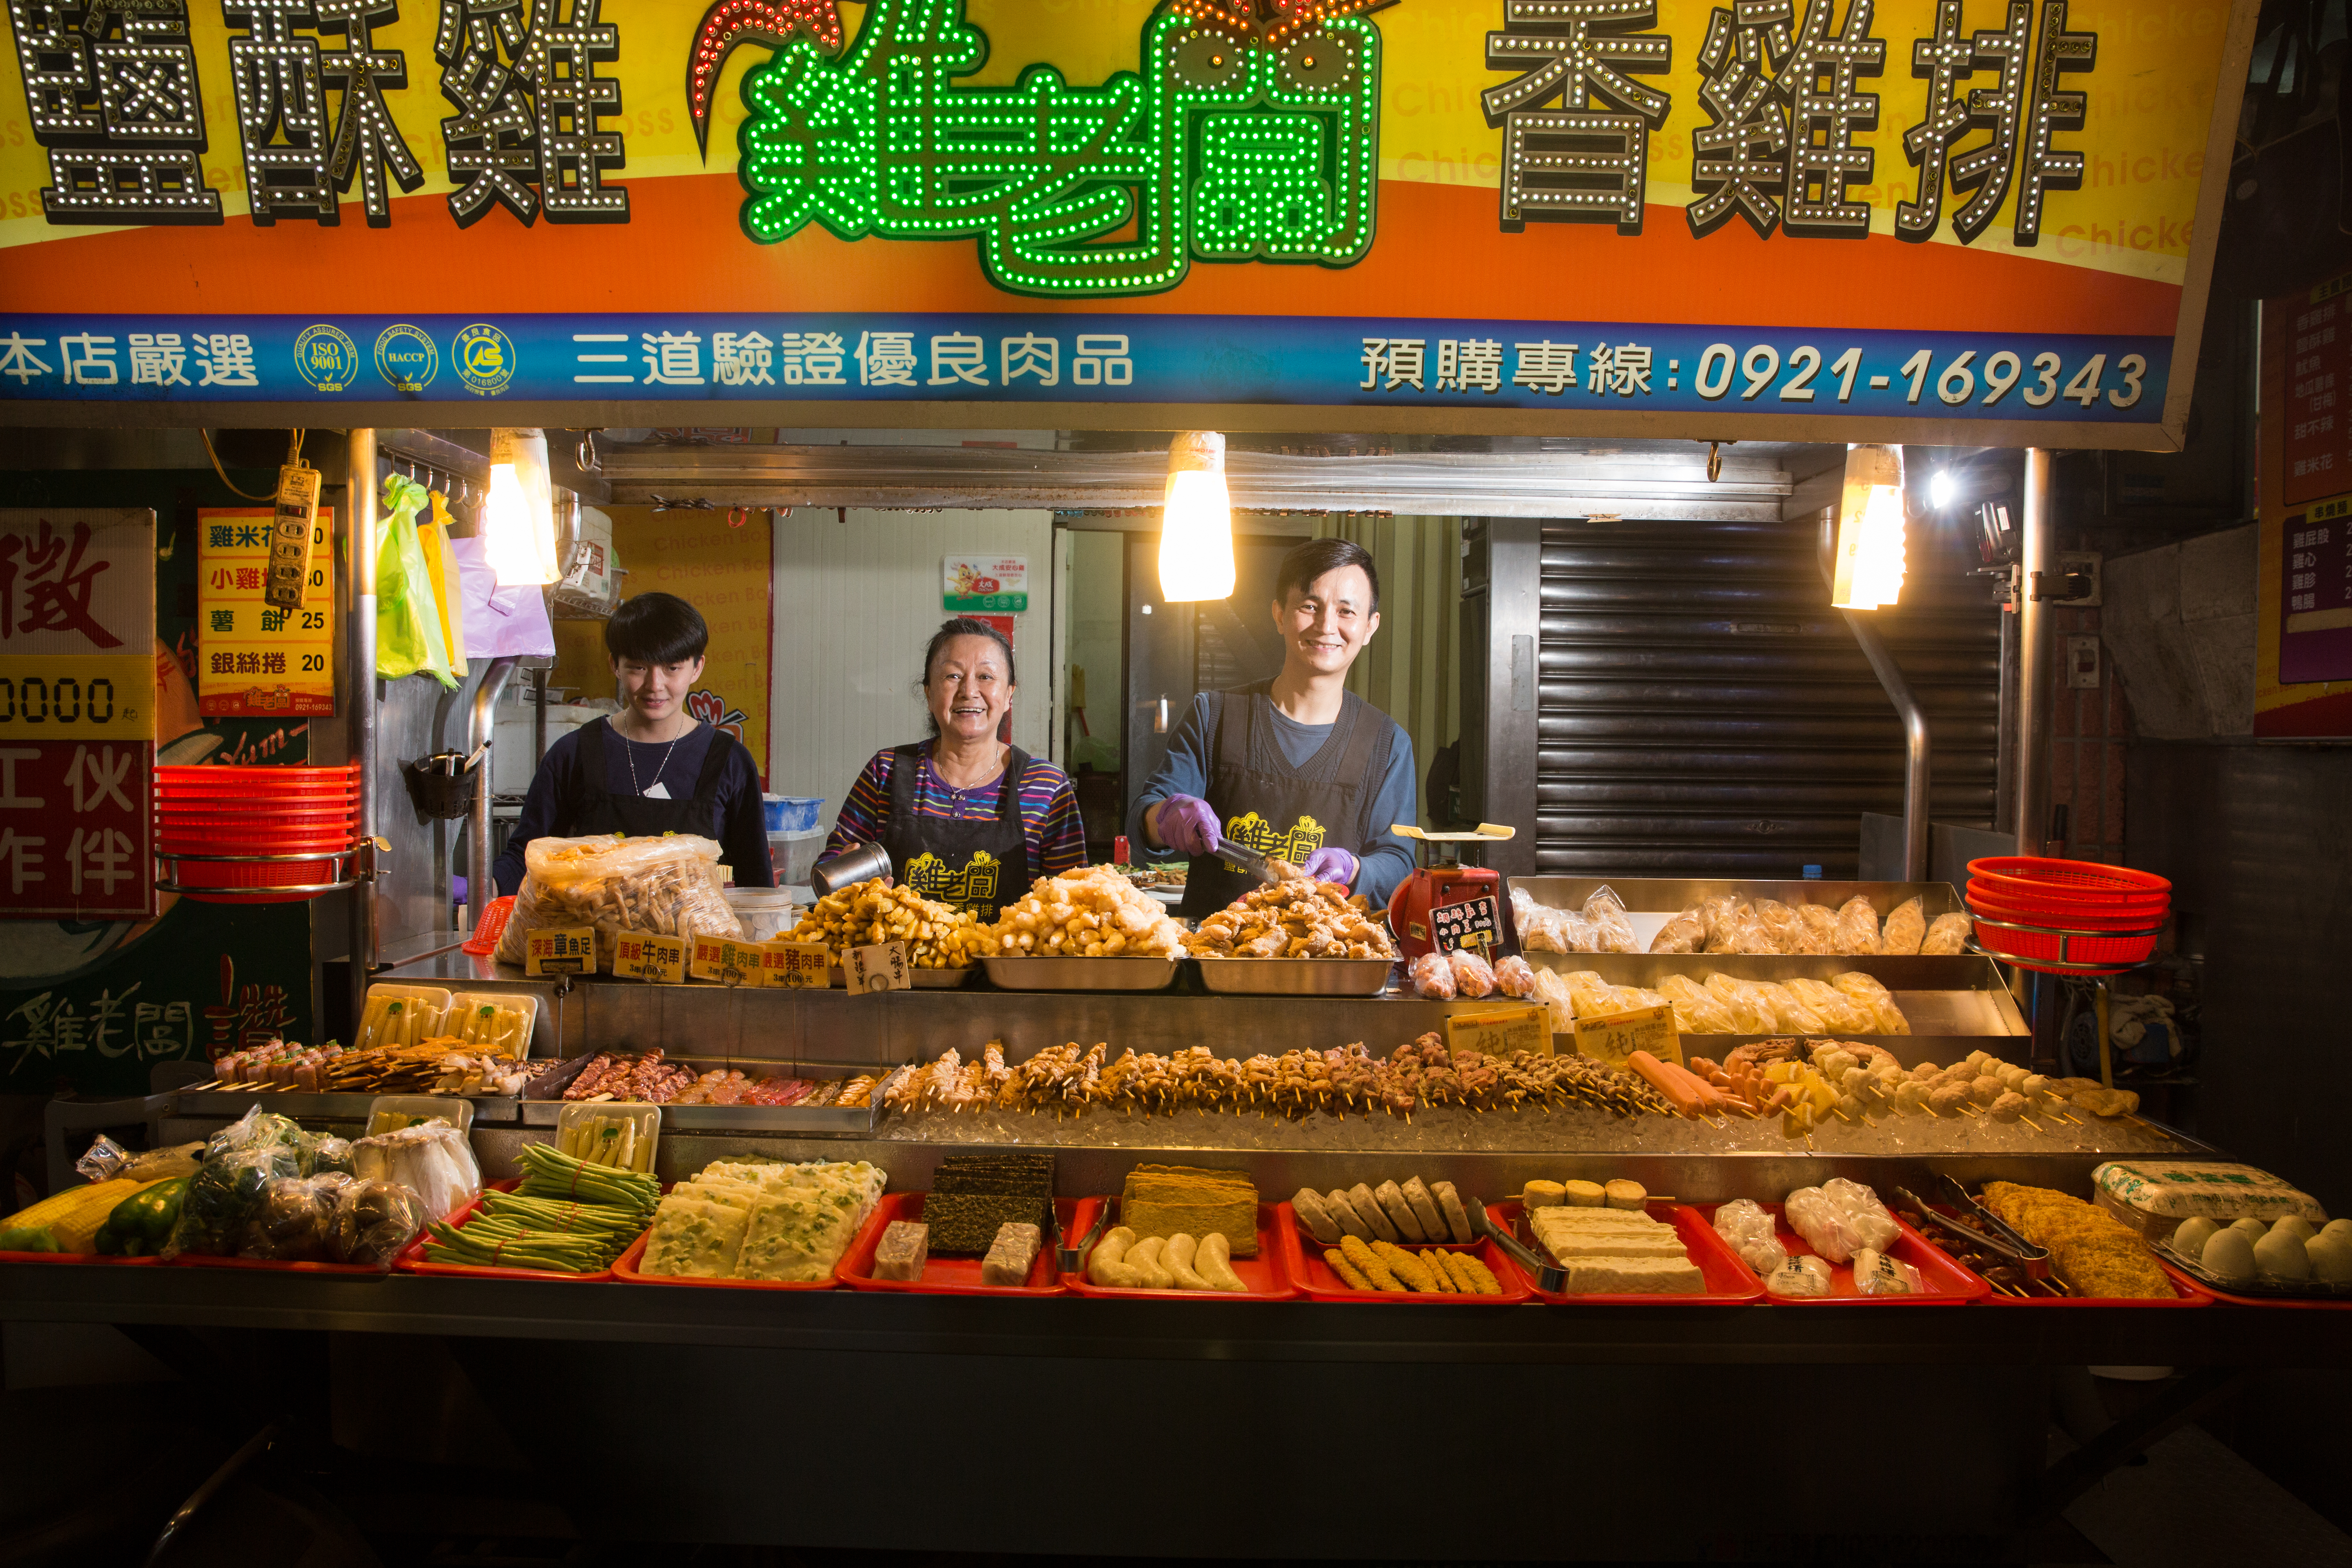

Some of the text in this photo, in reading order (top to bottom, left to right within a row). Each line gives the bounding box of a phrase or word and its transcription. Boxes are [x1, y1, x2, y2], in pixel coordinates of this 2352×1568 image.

[1481, 0, 2098, 247] 香雞排
[2296, 303, 2336, 332] 香雞排
[297, 327, 355, 358] QUALITY ASSURED FIRM
[311, 343, 339, 356] ISO
[378, 327, 434, 355] FOOD SAFETY SYSTEM
[2296, 326, 2336, 355] 鹽酥雞
[0, 332, 258, 388] 本店嚴選
[311, 356, 343, 370] 9001
[389, 353, 425, 362] HACCP
[573, 330, 1134, 388] 三道驗證優良肉品
[318, 383, 343, 392] SGS
[398, 383, 423, 392] SGS
[1695, 342, 2147, 409] 0921-169343
[2295, 373, 2335, 399] 地瓜薯條
[2294, 415, 2334, 440] 甜不辣
[2294, 453, 2334, 478] 雞米花
[2314, 501, 2348, 519] 串燒類
[2292, 528, 2330, 549] 雞屁股
[2292, 552, 2317, 570] 雞心
[0, 517, 125, 649] 徵
[210, 567, 268, 590] 小雞
[301, 612, 324, 629] 25
[211, 652, 324, 674] 銀絲捲 20
[532, 933, 591, 958] 深海章魚足
[619, 940, 680, 966] 頂級牛肉串
[696, 943, 760, 969] 嚴選雞肉串
[763, 948, 825, 971] 嚴選豬肉串
